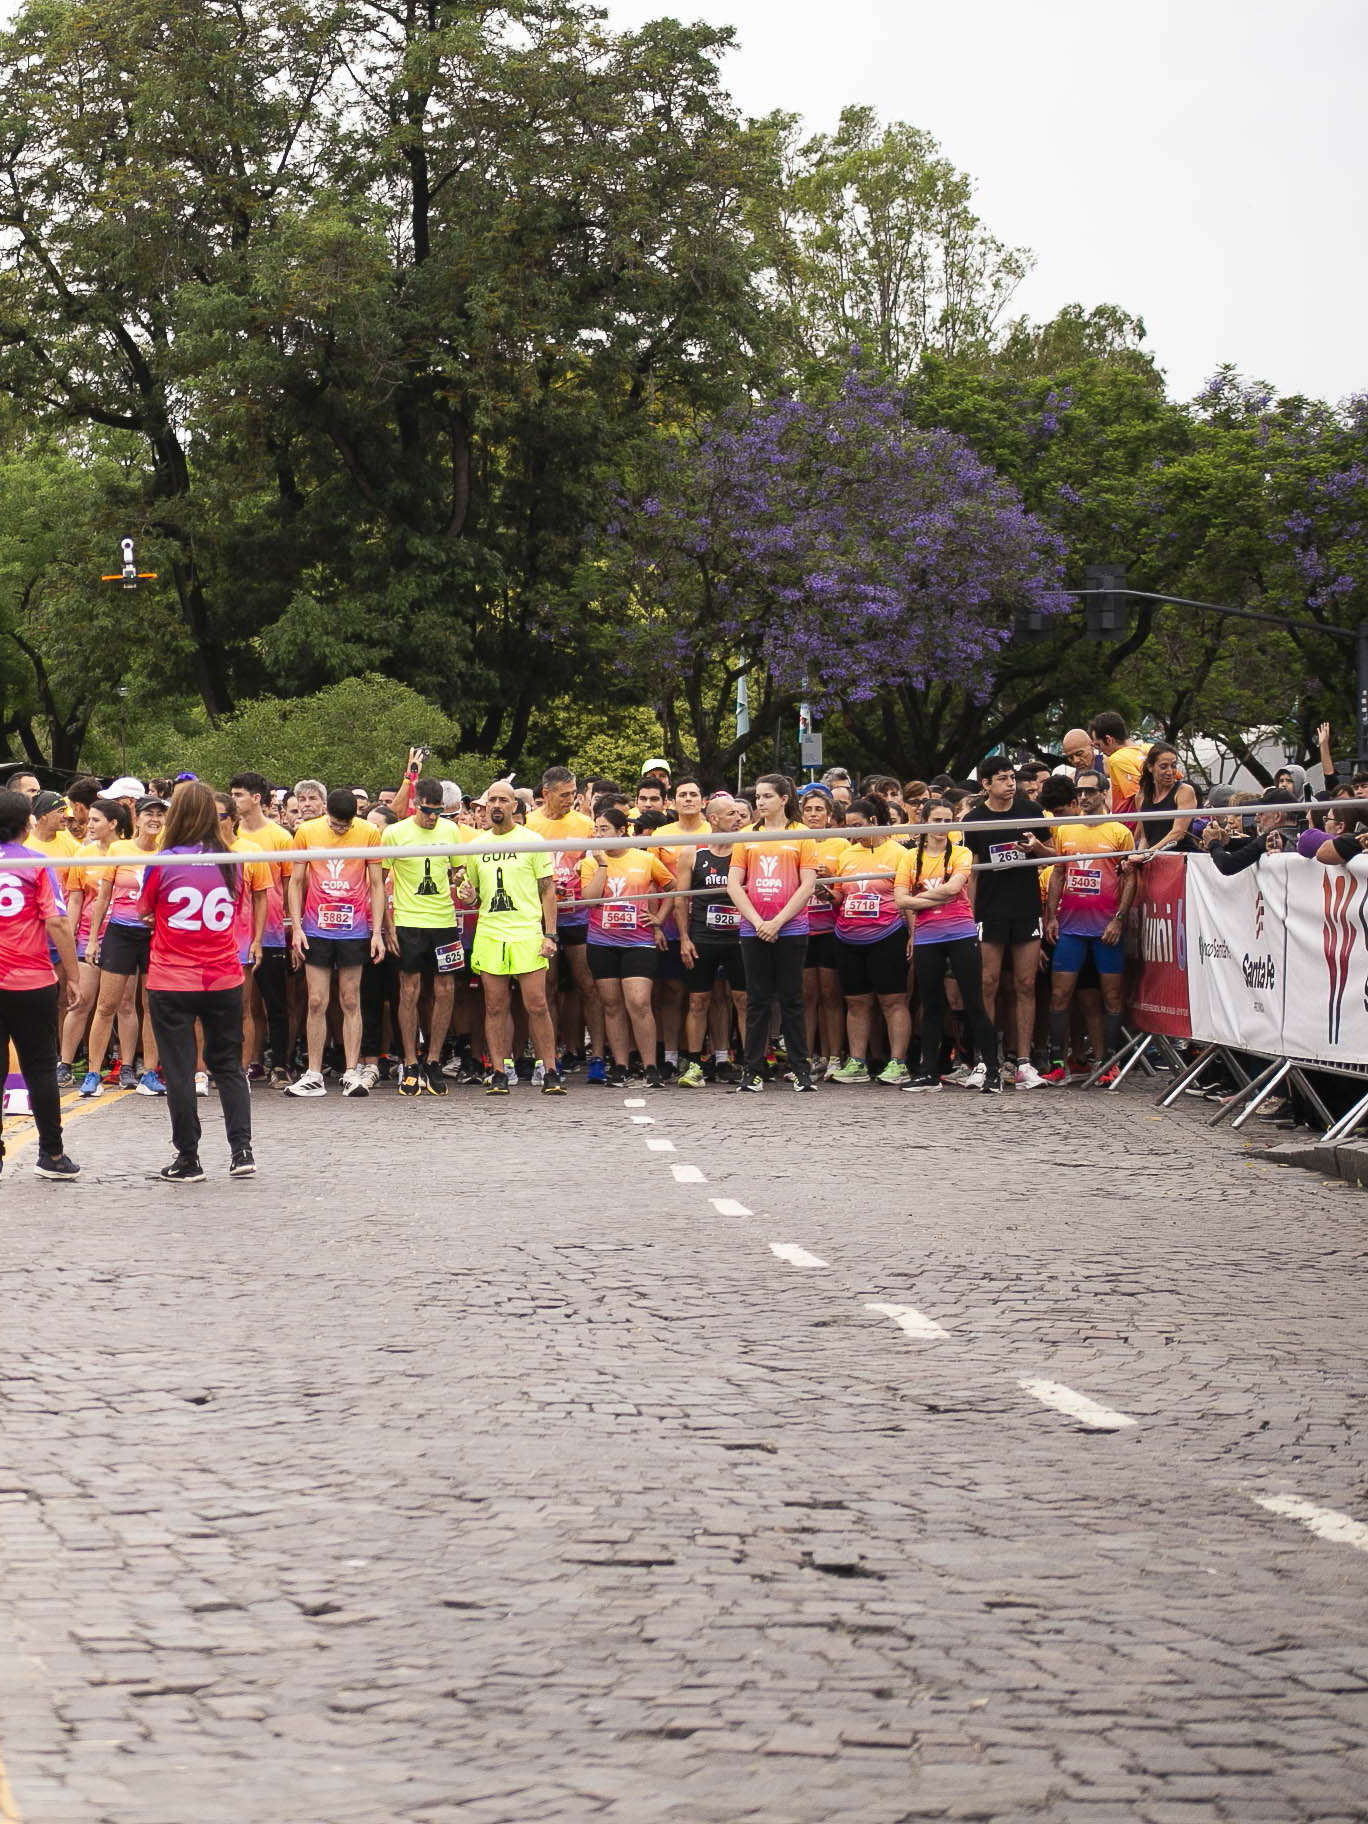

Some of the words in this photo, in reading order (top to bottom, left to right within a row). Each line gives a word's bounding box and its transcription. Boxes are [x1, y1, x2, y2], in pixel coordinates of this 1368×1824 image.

[998, 851, 1019, 863] 263
[322, 880, 350, 890] COPA
[755, 878, 783, 888] COPA
[1071, 877, 1097, 888] 5403
[167, 886, 235, 932] 26
[849, 900, 875, 910] 5718
[323, 912, 349, 923] 5882
[607, 912, 633, 922] 5643
[715, 914, 735, 925] 928
[445, 951, 462, 964] 625
[1242, 952, 1265, 989] Santa
[1265, 953, 1275, 991] Fe
